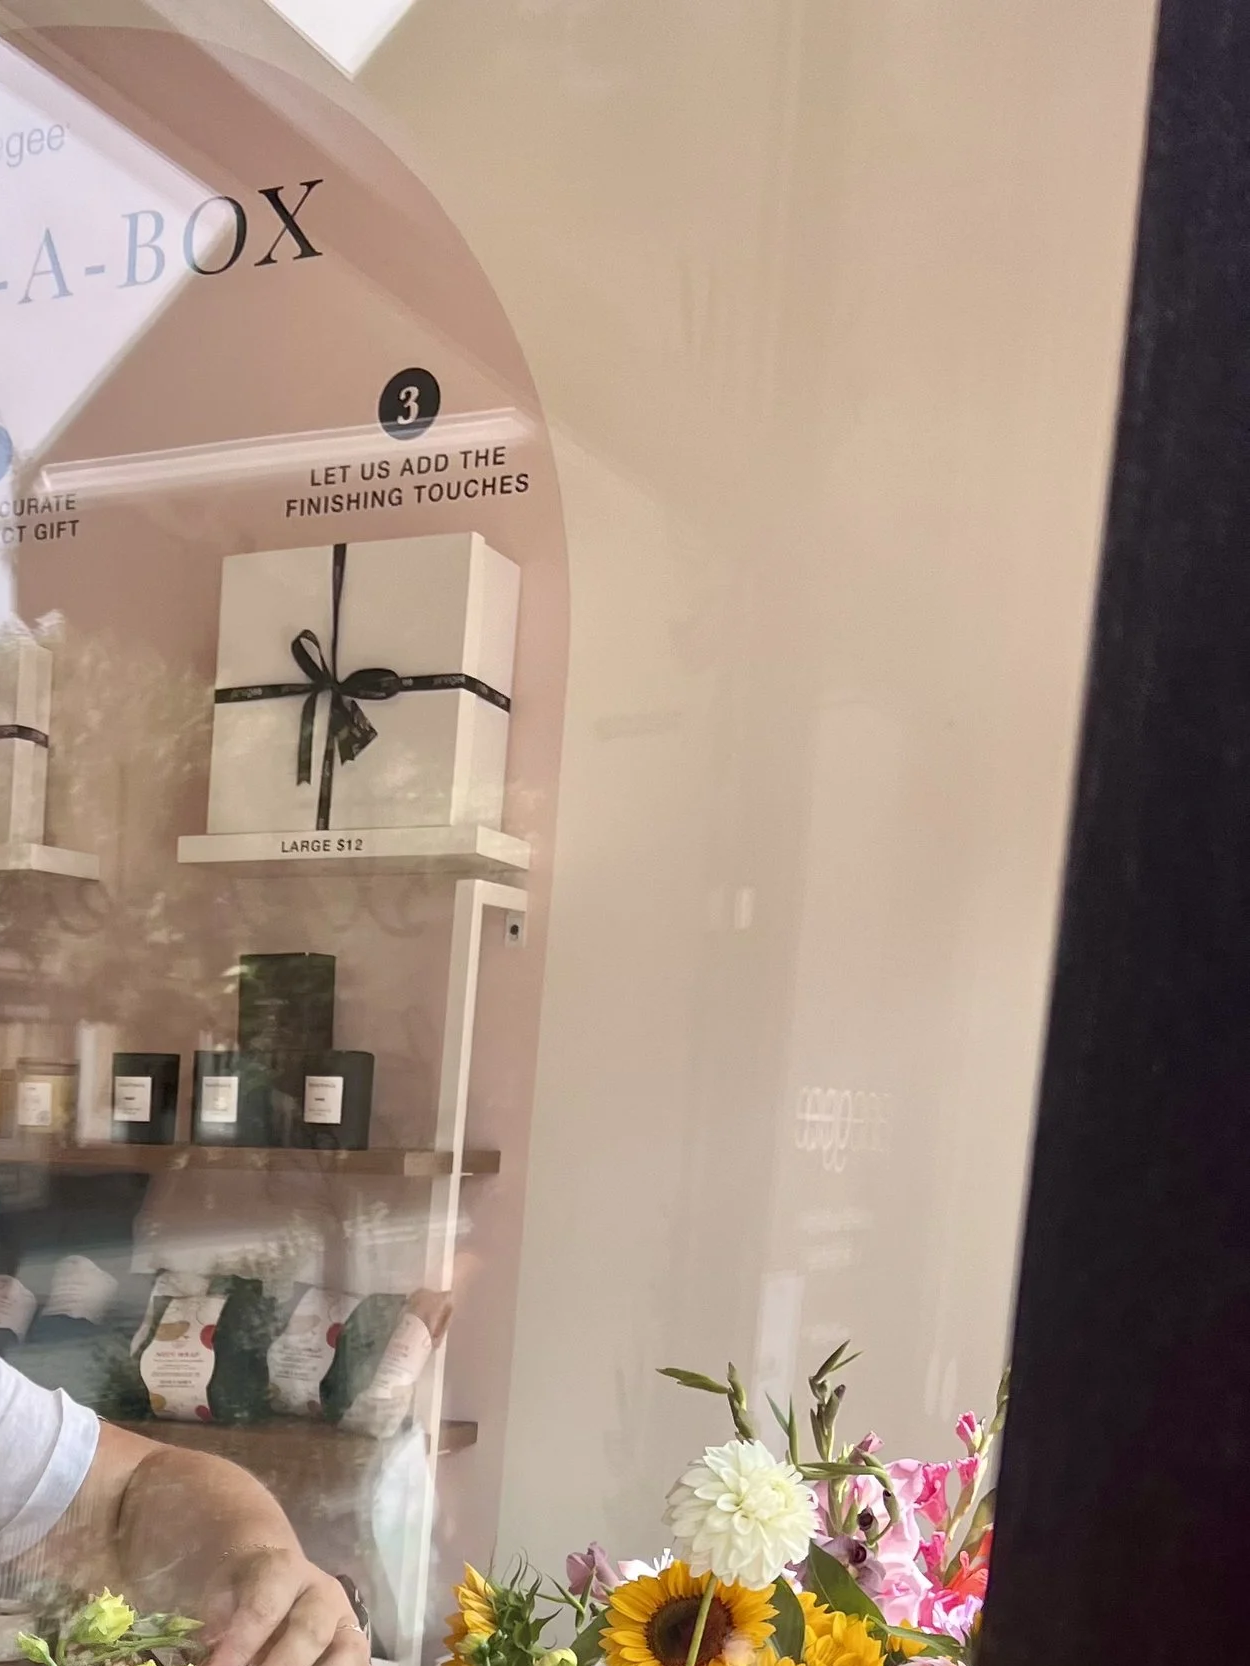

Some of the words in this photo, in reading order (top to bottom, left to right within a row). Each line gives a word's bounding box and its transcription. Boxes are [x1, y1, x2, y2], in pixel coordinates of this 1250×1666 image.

[397, 385, 420, 425] 3
[310, 465, 352, 487] LET
[360, 460, 391, 481] US
[399, 454, 449, 477] ADD
[460, 446, 507, 469] THE
[0, 493, 77, 518] CURATE
[285, 487, 403, 517] FINISHING
[414, 473, 530, 503] TOUCHES
[34, 519, 80, 541] GIFT
[281, 839, 331, 853] LARGE
[336, 838, 364, 852] $12
